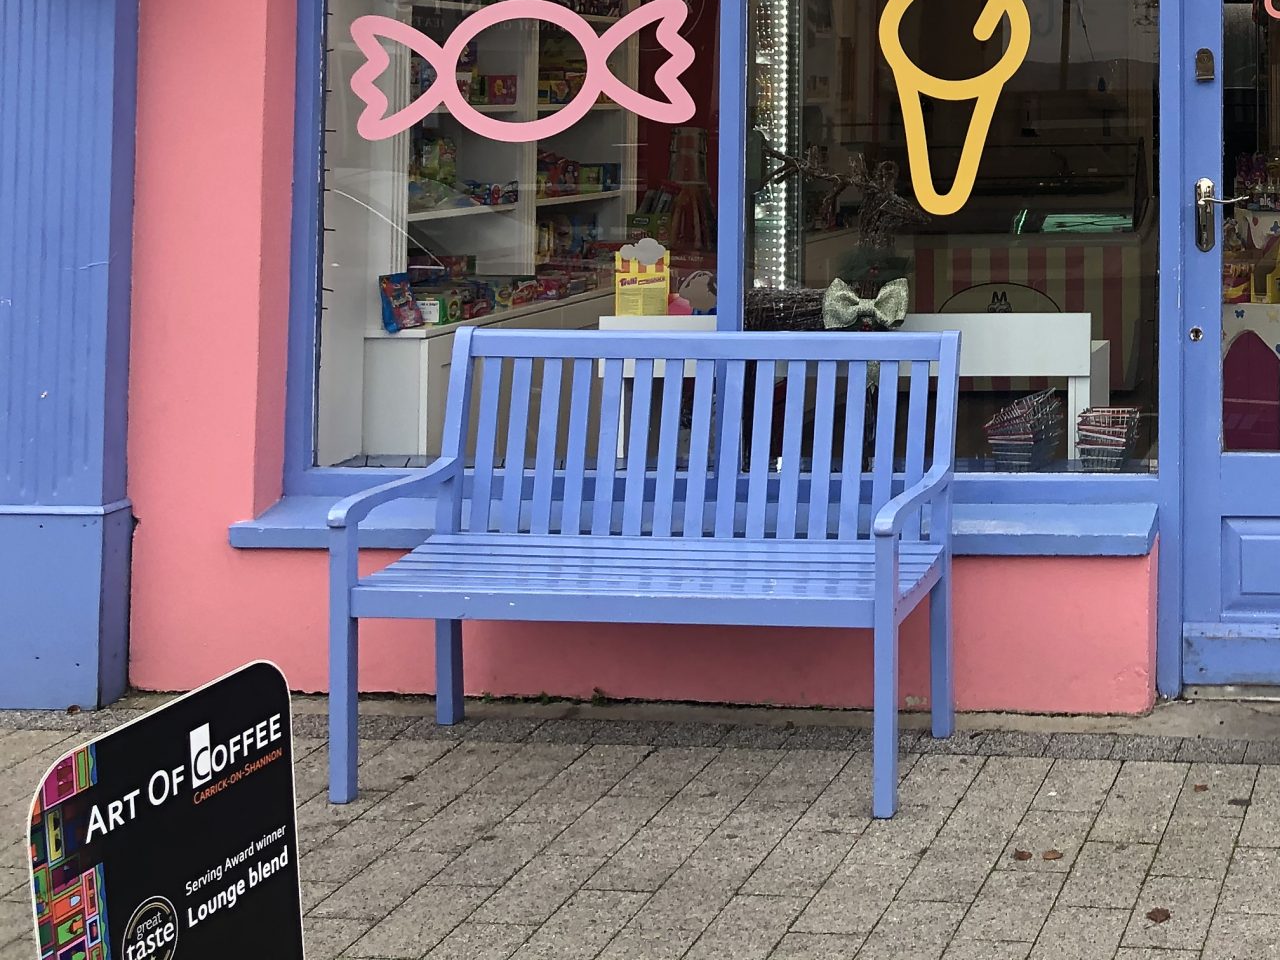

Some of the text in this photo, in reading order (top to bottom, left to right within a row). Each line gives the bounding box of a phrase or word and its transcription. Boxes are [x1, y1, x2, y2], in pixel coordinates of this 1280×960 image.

[86, 713, 282, 844] ART OF COFFEE
[193, 747, 282, 805] CARRICK-ON-SHANNON
[185, 825, 286, 896] Serving Award winner
[188, 844, 289, 928] Lounge blend
[126, 922, 175, 960] taste
[136, 911, 163, 940] great
